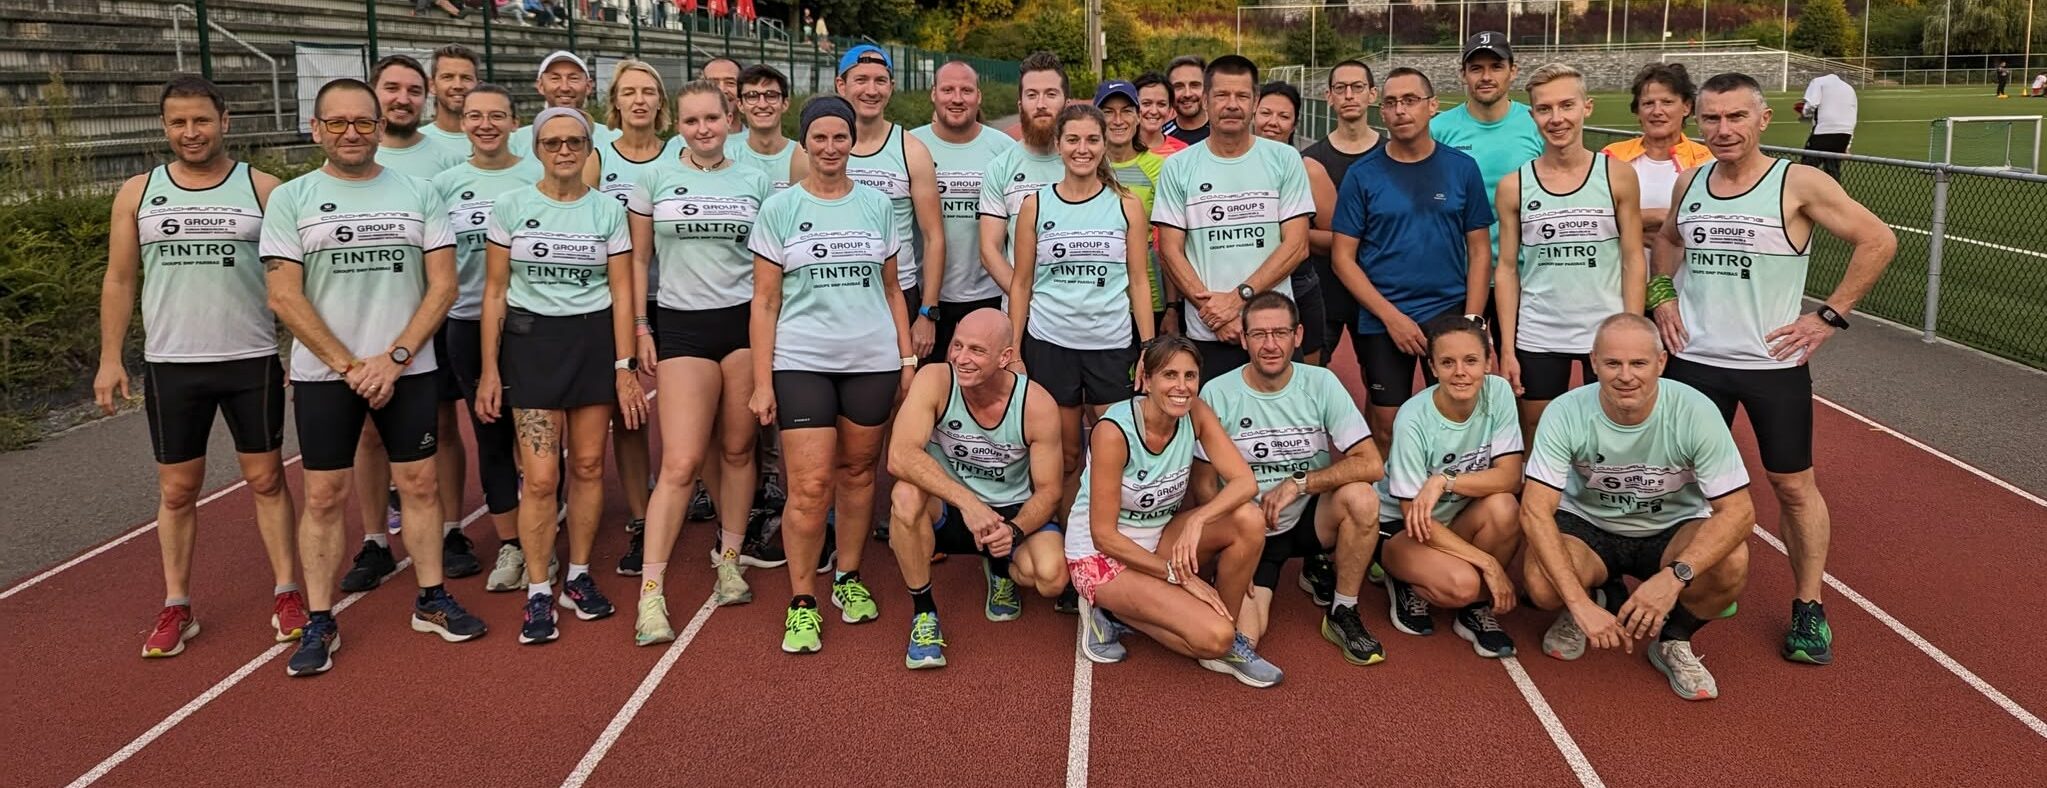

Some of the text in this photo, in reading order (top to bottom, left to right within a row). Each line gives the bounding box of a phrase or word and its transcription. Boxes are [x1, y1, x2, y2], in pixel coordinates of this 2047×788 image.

[887, 180, 894, 188] S
[1227, 203, 1257, 212] GROUP
[184, 218, 226, 226] GROUP
[229, 218, 237, 226] S
[356, 223, 396, 232] GROUP
[398, 223, 406, 231] S
[1558, 221, 1589, 229] GROUP
[675, 222, 749, 235] FINTRO
[1208, 226, 1265, 242] FINTRO
[1710, 227, 1745, 236] GROUP
[1747, 229, 1755, 237] S
[159, 244, 236, 257] FINTRO
[552, 243, 589, 252] GROUP
[590, 245, 596, 253] S
[830, 242, 863, 250] GROUP
[865, 241, 871, 249] S
[1069, 241, 1102, 249] GROUP
[1104, 241, 1110, 249] S
[331, 249, 405, 265] FINTRO
[1538, 245, 1596, 259] FINTRO
[1691, 252, 1752, 268] FINTRO
[527, 265, 592, 279] FINTRO
[809, 265, 872, 280] FINTRO
[1050, 265, 1108, 277] FINTRO
[1270, 439, 1302, 448] GROUP
[1304, 438, 1310, 446] S
[971, 447, 1002, 457] GROUP
[1250, 461, 1309, 474] FINTRO
[1157, 481, 1185, 497] GROUP
